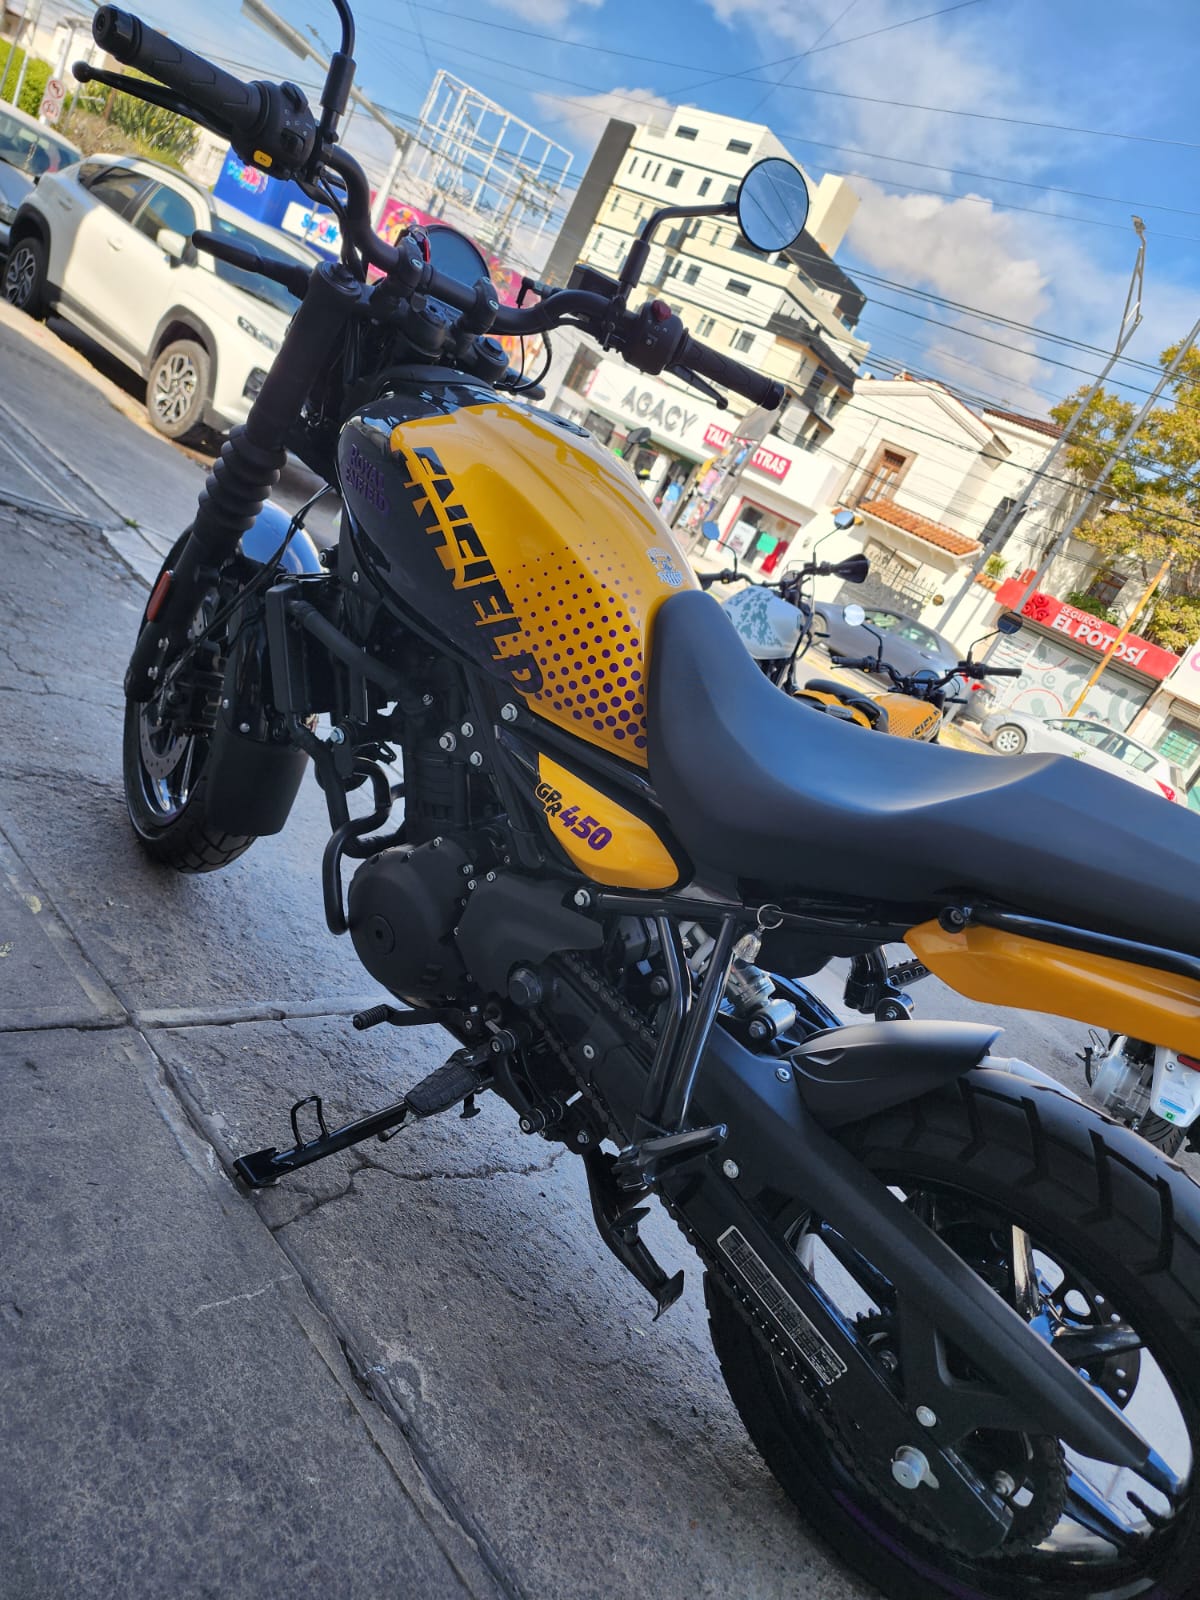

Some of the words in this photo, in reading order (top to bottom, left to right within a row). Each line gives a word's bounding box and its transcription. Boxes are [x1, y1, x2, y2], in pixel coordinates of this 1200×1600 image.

[621, 385, 698, 437] AGACY
[1050, 613, 1073, 635] EL
[1061, 606, 1102, 629] SEGUROS
